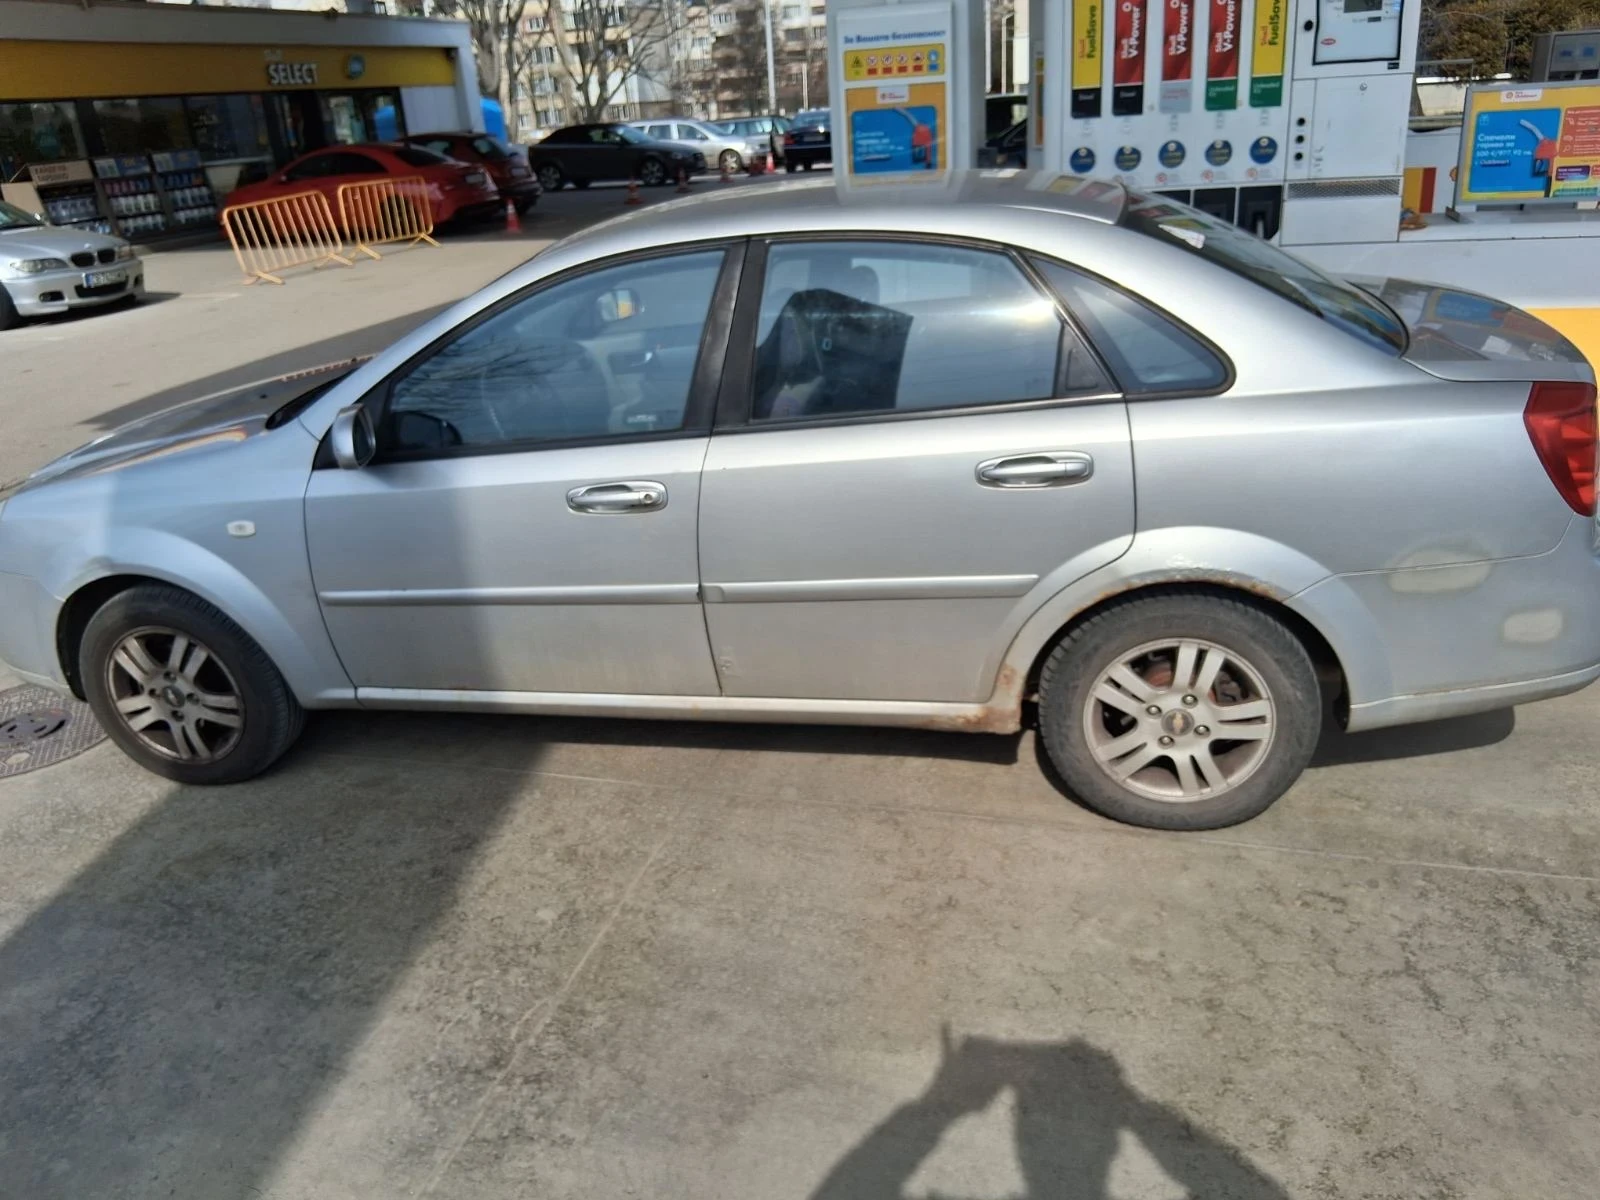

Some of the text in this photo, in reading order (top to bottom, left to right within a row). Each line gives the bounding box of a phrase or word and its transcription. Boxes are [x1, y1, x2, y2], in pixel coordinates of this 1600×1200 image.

[1086, 5, 1097, 59] FuelSave
[1128, 7, 1141, 58] V-Power
[1175, 3, 1189, 55] V-Power
[1269, 0, 1280, 46] FuelSav
[1120, 38, 1128, 59] Shell
[268, 63, 318, 85] SELECT
